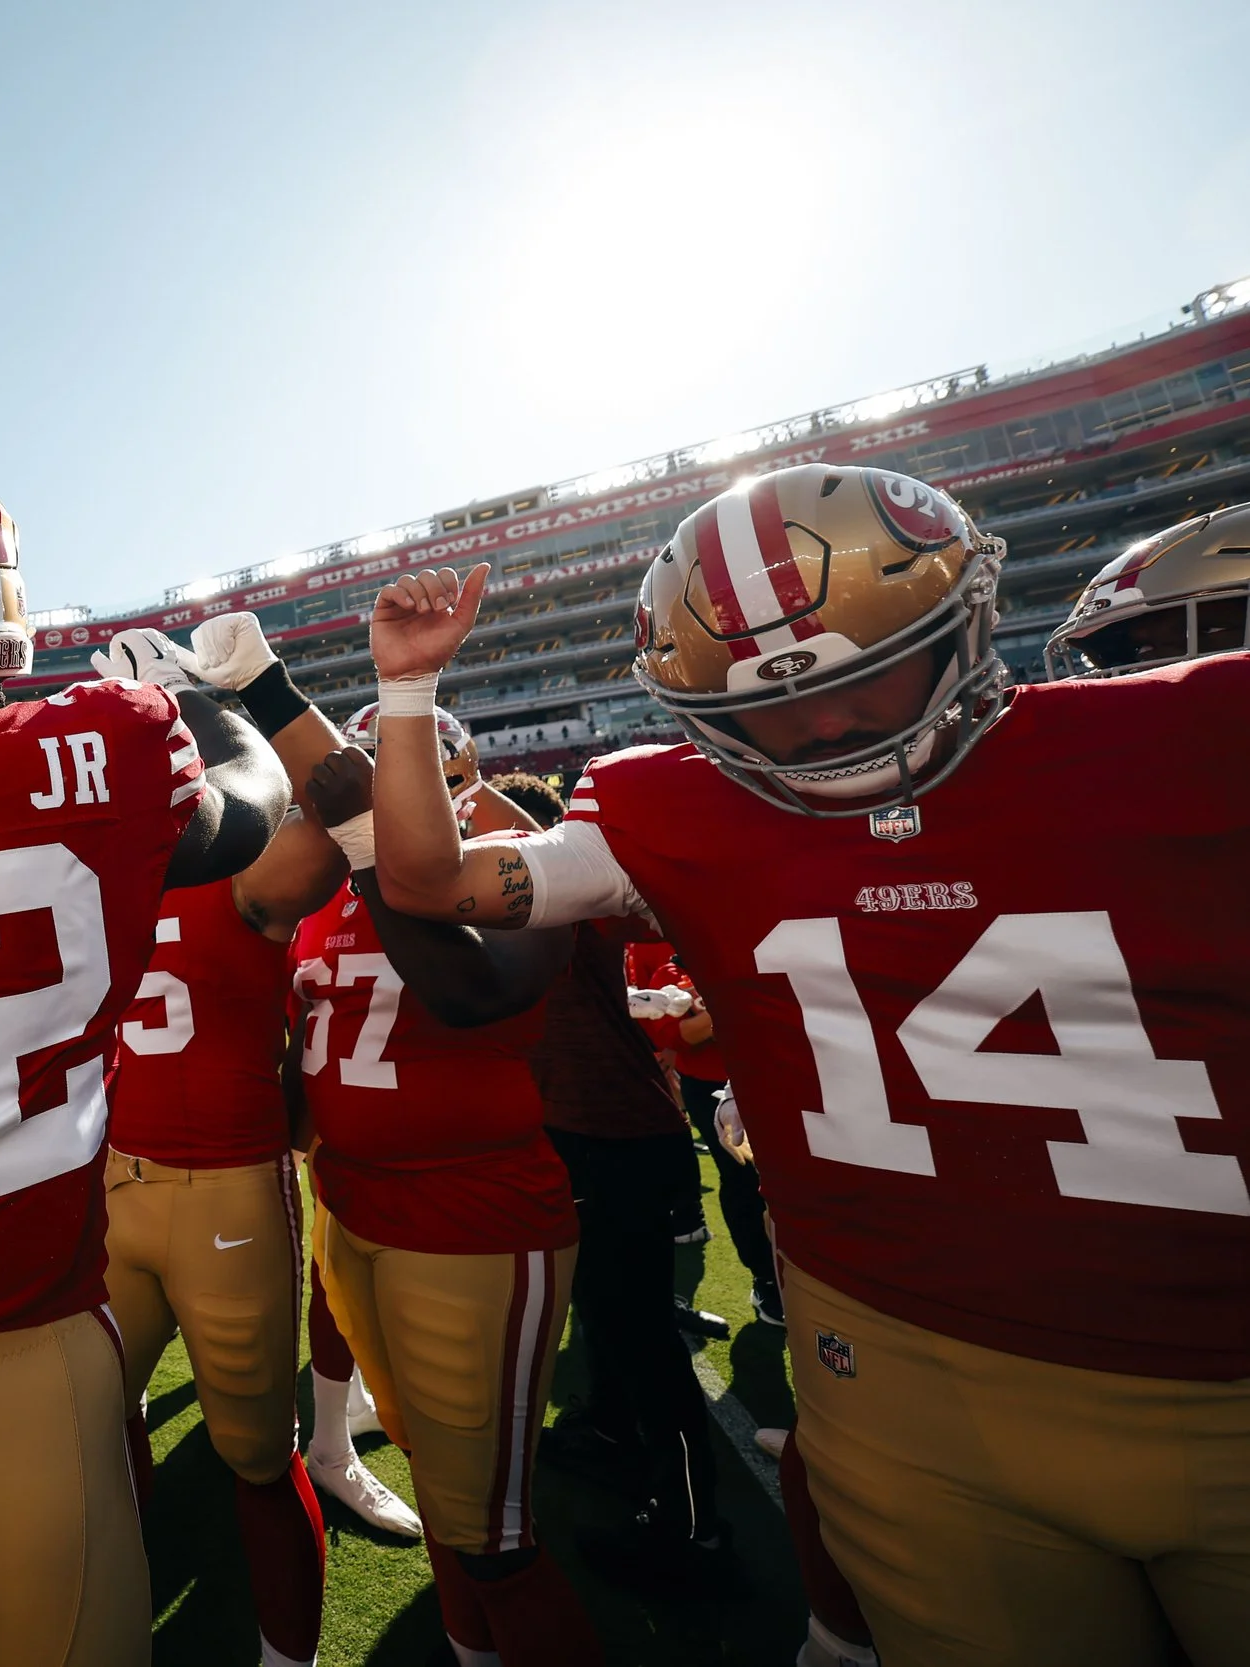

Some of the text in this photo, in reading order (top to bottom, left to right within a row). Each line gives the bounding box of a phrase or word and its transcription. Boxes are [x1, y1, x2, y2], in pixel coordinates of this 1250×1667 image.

[948, 457, 1067, 489] CHAMPIONS
[162, 609, 192, 626] XVI
[203, 599, 233, 616] XIX
[243, 585, 288, 606] XXIII
[306, 555, 400, 590] SUPER
[406, 532, 499, 565] BOWL
[505, 471, 731, 540] CHAMPIONS
[849, 419, 931, 453] XXIX
[533, 546, 665, 584] FAITHFU
[30, 730, 110, 811] JR
[877, 819, 912, 836] NFL
[854, 881, 978, 912] 49ERS
[324, 932, 356, 950] 49ERS
[292, 952, 405, 1090] 67
[753, 911, 1250, 1217] 14
[822, 1348, 850, 1372] NFL
